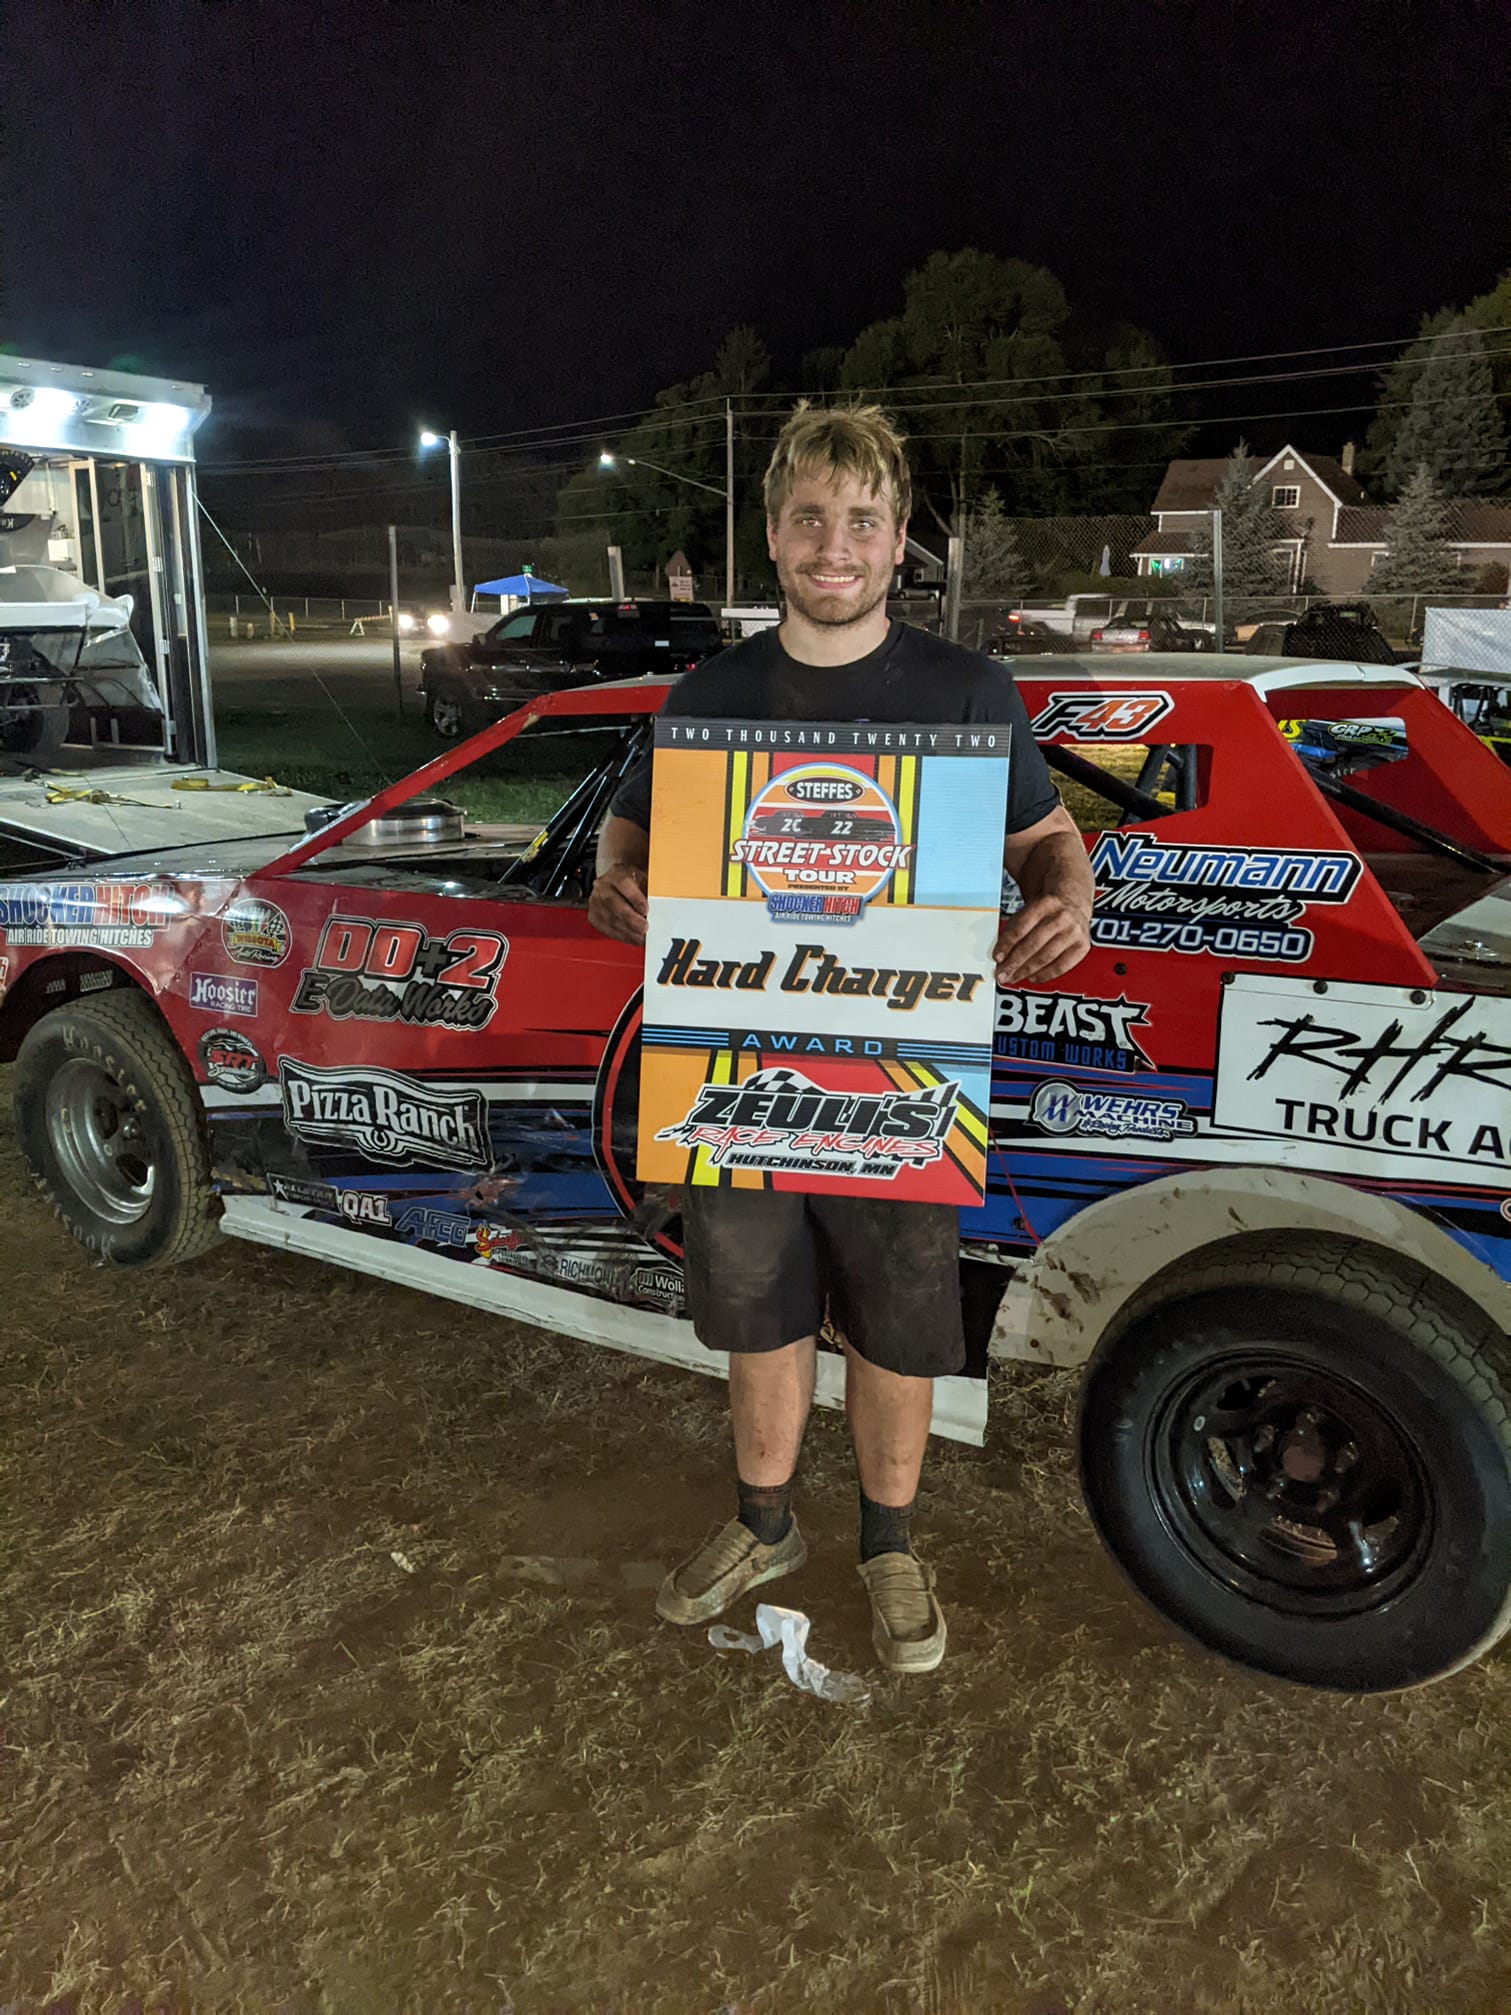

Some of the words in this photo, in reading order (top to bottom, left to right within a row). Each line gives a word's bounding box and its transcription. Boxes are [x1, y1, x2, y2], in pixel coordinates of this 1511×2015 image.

[1033, 698, 1161, 730] F43
[671, 727, 710, 741] TWO
[726, 729, 836, 744] THOUSAND
[853, 732, 938, 747] TWENTY
[955, 734, 996, 748] TWO
[1331, 724, 1373, 737] GRP
[796, 782, 853, 799] STEFFES
[831, 821, 853, 835] 22
[784, 869, 855, 884] TOUR
[1091, 837, 1353, 894] Neumann
[1095, 881, 1300, 924] Motorsports
[8, 928, 24, 945] AIR
[26, 928, 49, 945] RIDE
[51, 928, 98, 945] TOWING
[100, 929, 153, 945] HITCHES
[657, 938, 777, 991] Hard
[780, 943, 985, 1012] Charger
[191, 977, 256, 1005] Hoosier
[401, 981, 494, 1027] Works
[994, 994, 1141, 1050] BEAST
[742, 1034, 882, 1055] AWARD
[993, 1035, 1056, 1061] USTOM
[1065, 1043, 1127, 1070] WORKS
[288, 1080, 373, 1124] Pizza
[373, 1085, 480, 1153] Ranch
[689, 1088, 940, 1138] ZEULI'S
[1074, 1110, 1194, 1131] MACHINE
[1083, 1094, 1183, 1120] WEHRS
[1275, 1098, 1452, 1153] TRUCK
[1467, 1124, 1511, 1160] A
[689, 1125, 780, 1163] RACE
[793, 1131, 940, 1160] ENGINES
[727, 1153, 857, 1176] HUTCHINSON,
[860, 1163, 899, 1177] MN
[344, 1193, 390, 1223] QA1
[396, 1207, 471, 1248] AFCO
[560, 1259, 618, 1287] RICHMON
[655, 1275, 685, 1293] Woll
